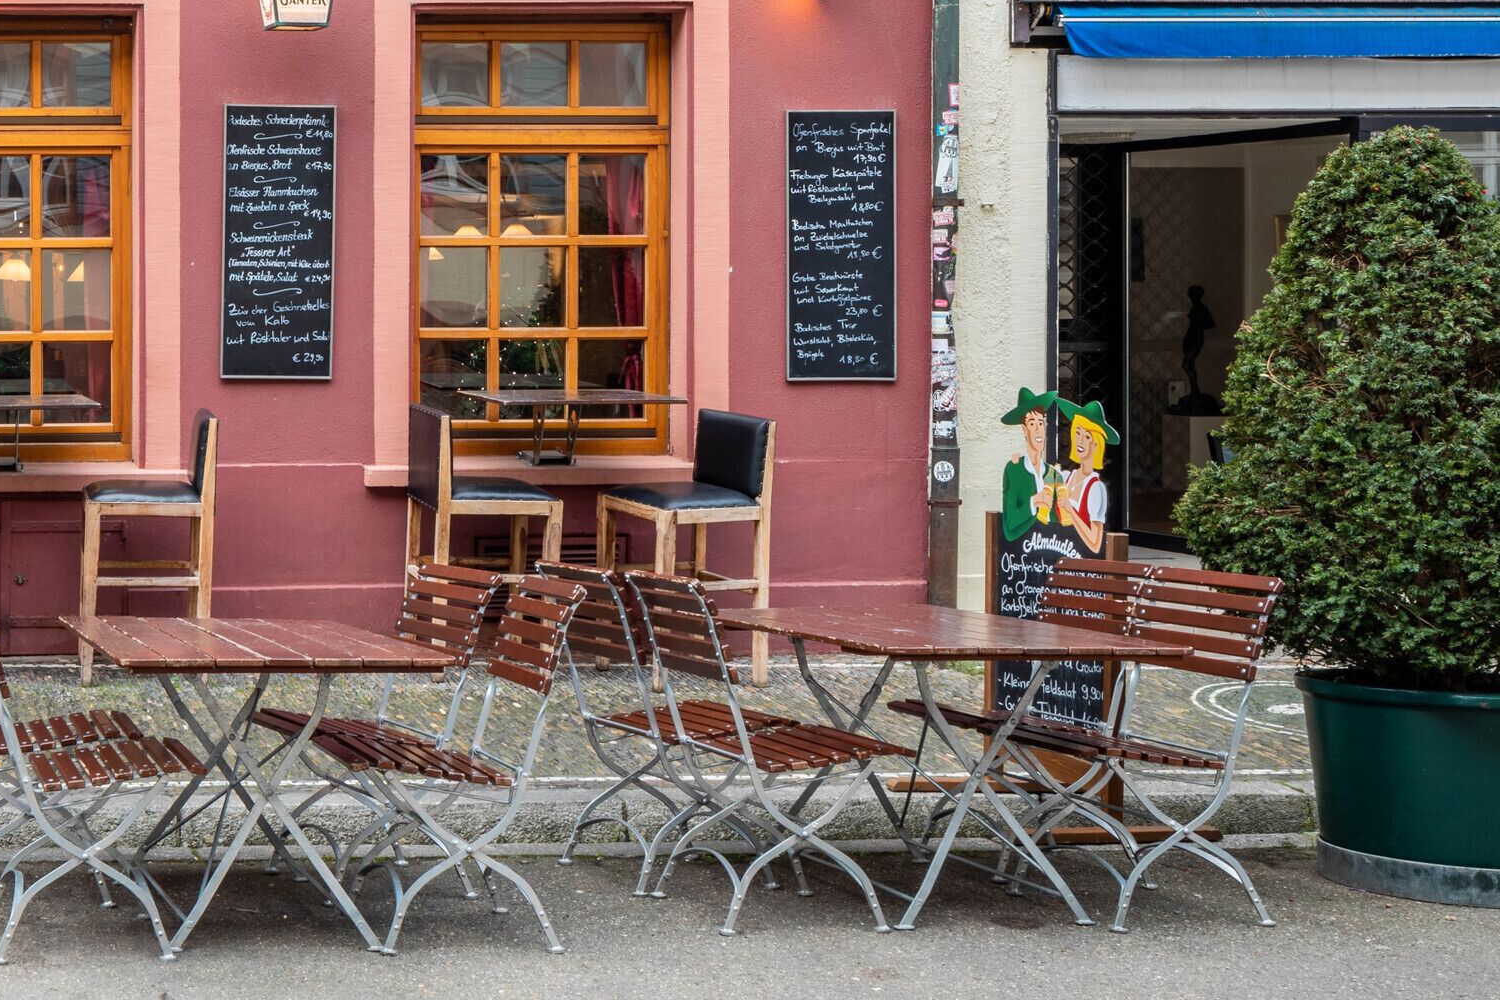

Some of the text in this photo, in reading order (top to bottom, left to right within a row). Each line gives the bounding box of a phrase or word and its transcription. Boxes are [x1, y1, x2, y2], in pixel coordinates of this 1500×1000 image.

[857, 182, 875, 191] und
[230, 202, 244, 212] mit
[794, 243, 810, 252] und
[229, 272, 244, 281] mit
[796, 296, 815, 305] und
[264, 315, 290, 326] Kalb
[293, 333, 310, 343] und
[1001, 552, 1054, 583] Ofenfrische
[1001, 584, 1013, 595] an
